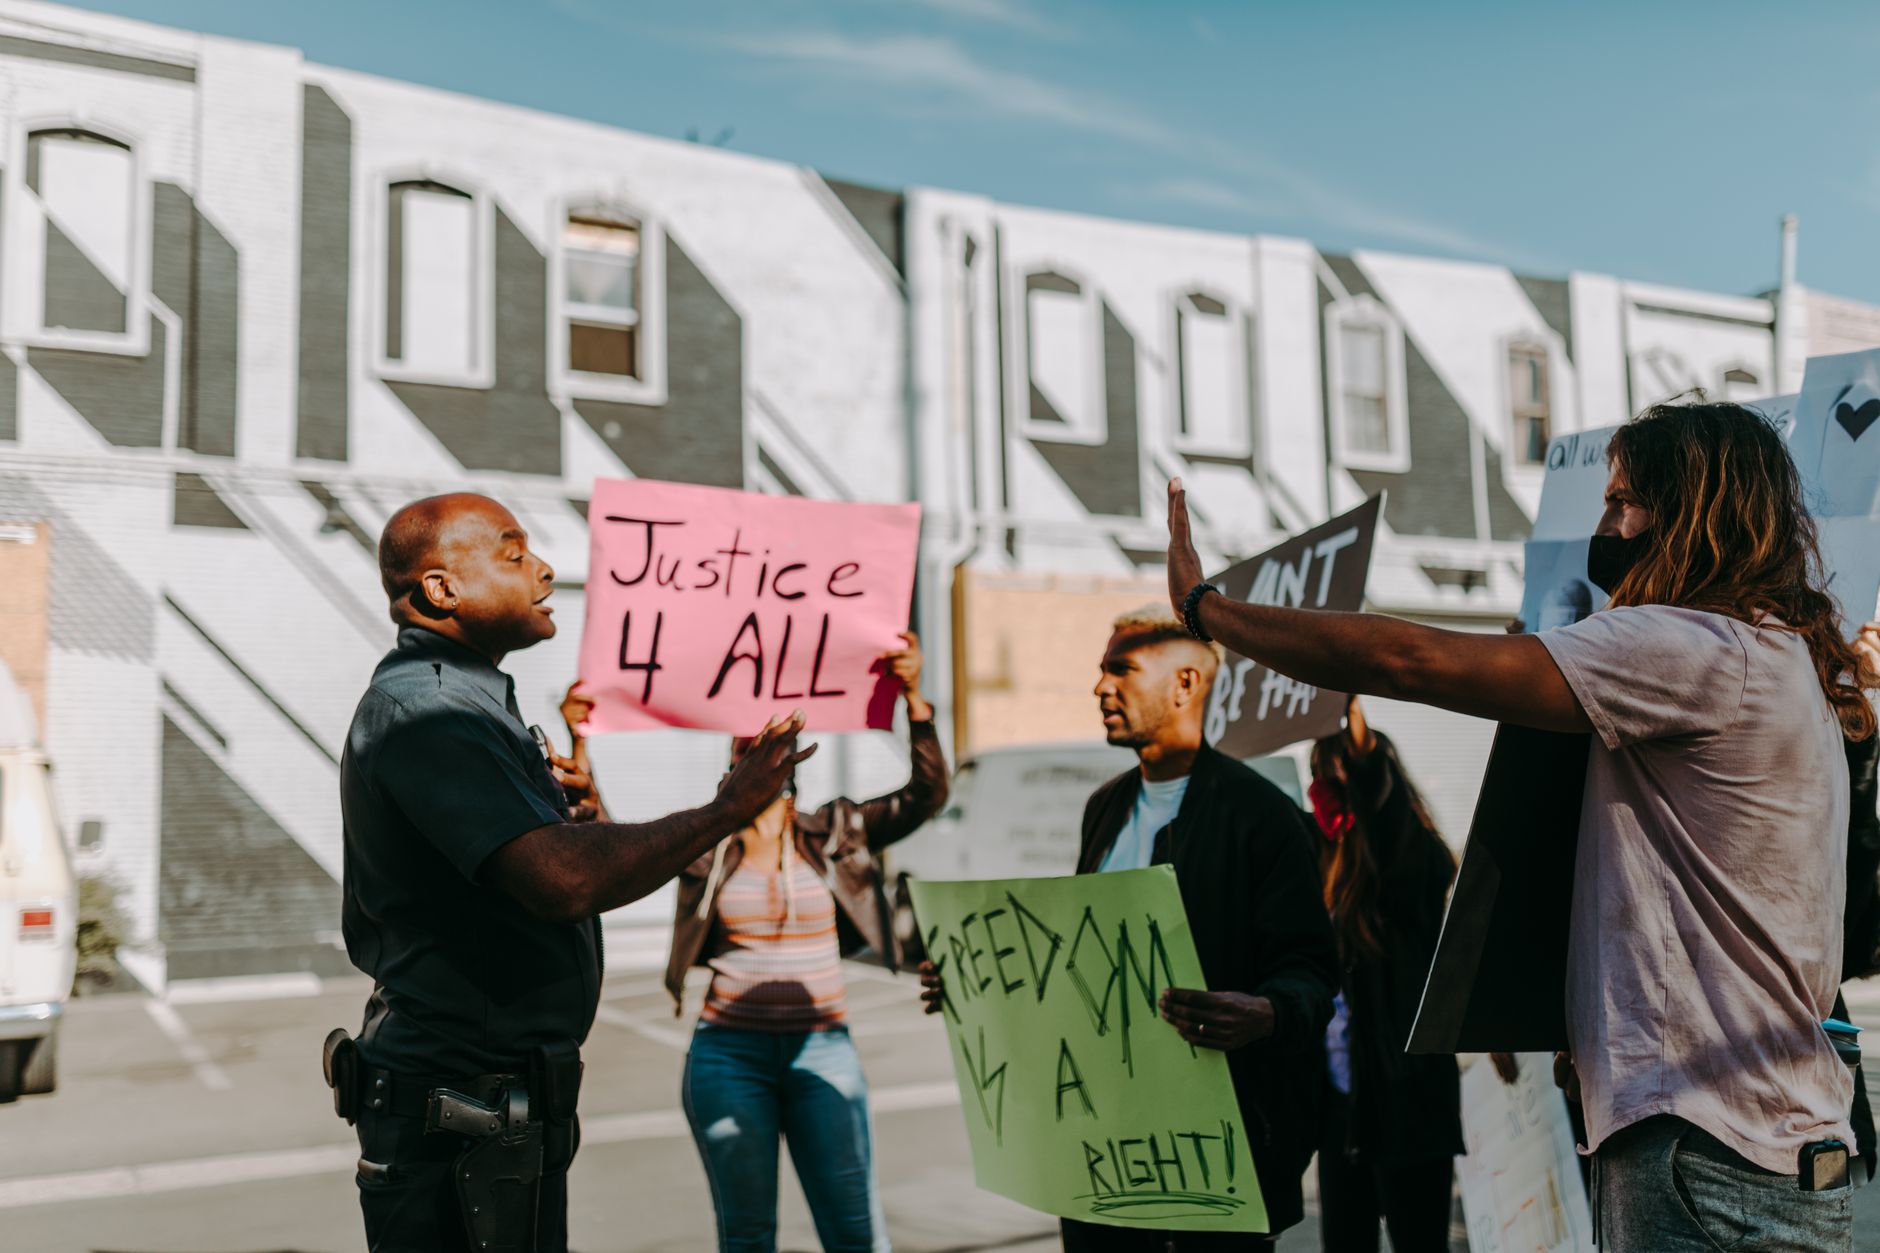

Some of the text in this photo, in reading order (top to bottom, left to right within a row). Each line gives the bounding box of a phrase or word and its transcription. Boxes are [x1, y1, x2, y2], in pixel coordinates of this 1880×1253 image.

[1548, 434, 1580, 471] all
[605, 516, 864, 600] Justice
[618, 610, 846, 706] 4 ALL
[927, 890, 1198, 1079] FREEDOM
[959, 1025, 1098, 1148] IS A
[1082, 1119, 1236, 1197] RIGHT!
